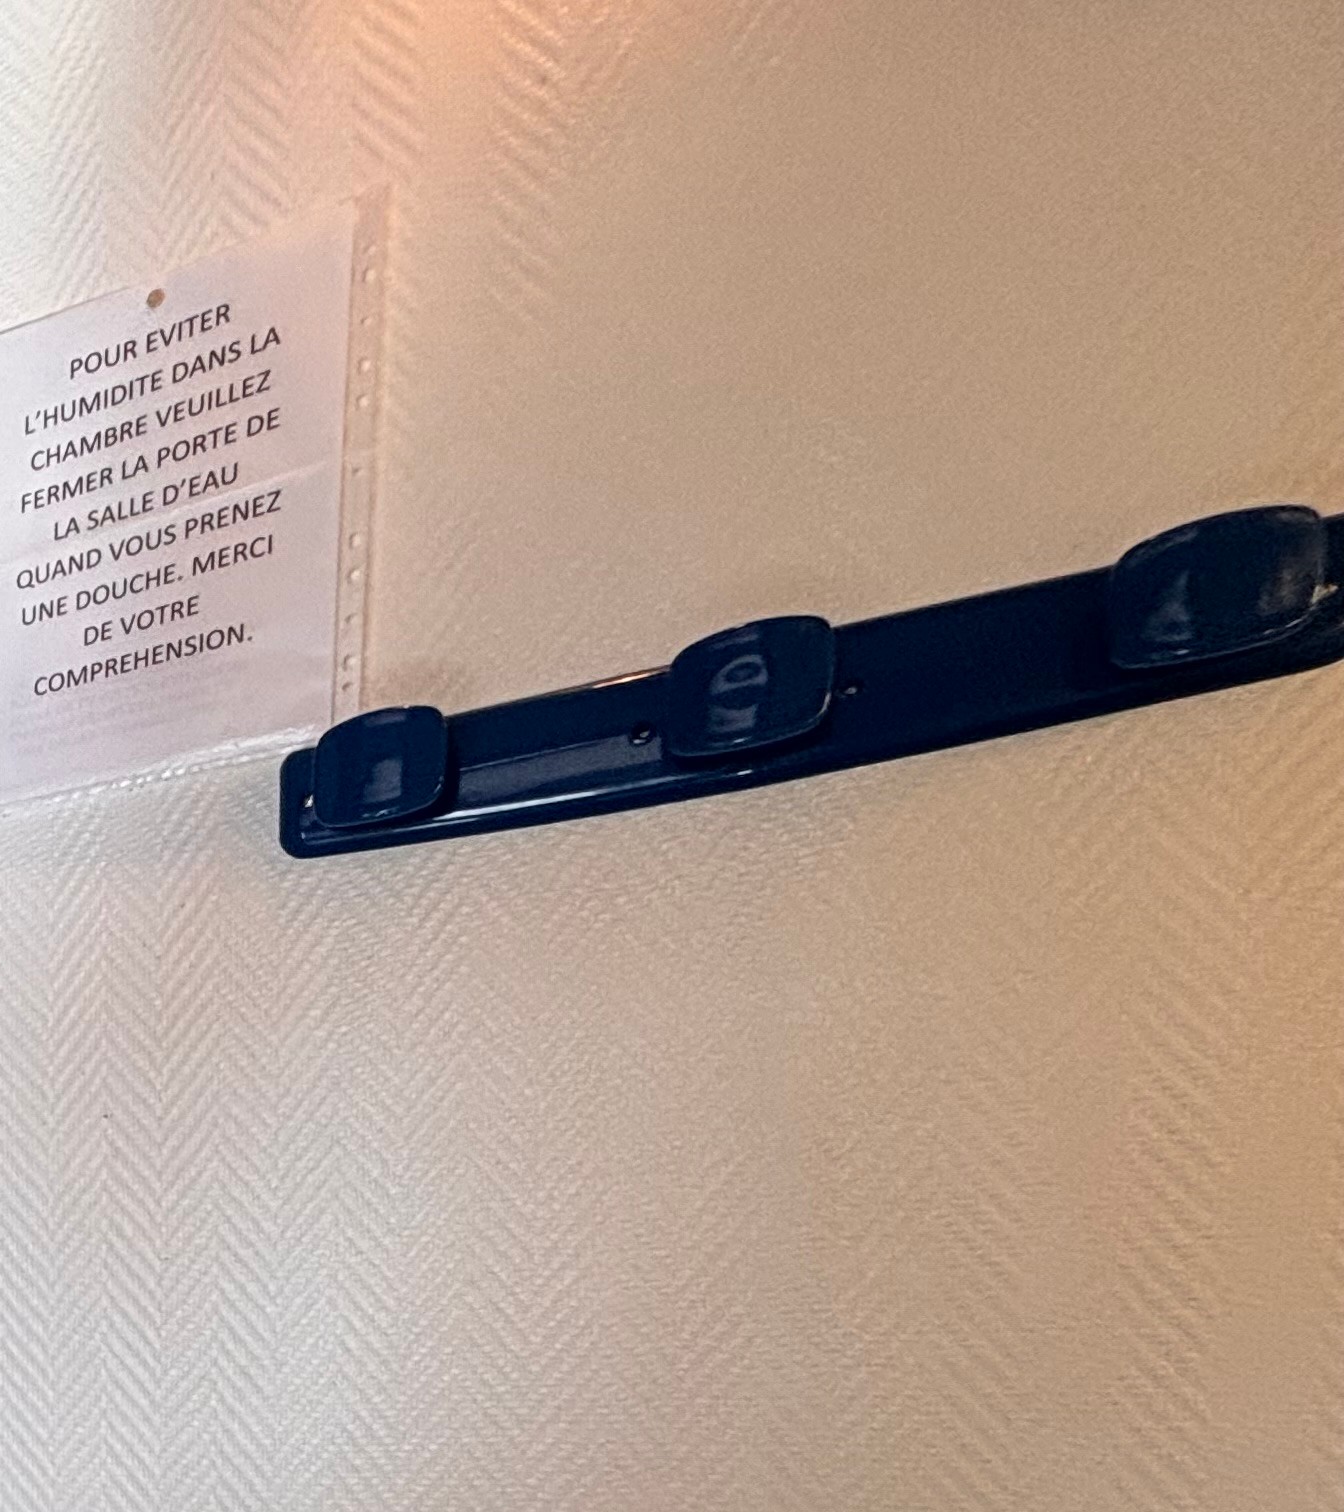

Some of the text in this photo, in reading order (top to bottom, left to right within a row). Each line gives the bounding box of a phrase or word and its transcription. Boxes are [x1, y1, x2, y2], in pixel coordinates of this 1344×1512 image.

[25, 327, 281, 435] L’HUMIDITE DANS LA
[70, 304, 231, 379] POUR EVITER
[21, 408, 280, 513] FERMER LA PORTE DE
[30, 370, 271, 471] CHAMBRE VEUILLEZ
[16, 490, 282, 590] QUAND VOUS PRENEZ
[54, 463, 238, 541] LA SALLE D’EAU
[21, 535, 273, 625] UNE DOUCHE. MERCI
[83, 595, 200, 646] DE VOTRE
[34, 623, 252, 696] COMPREHENSION.
